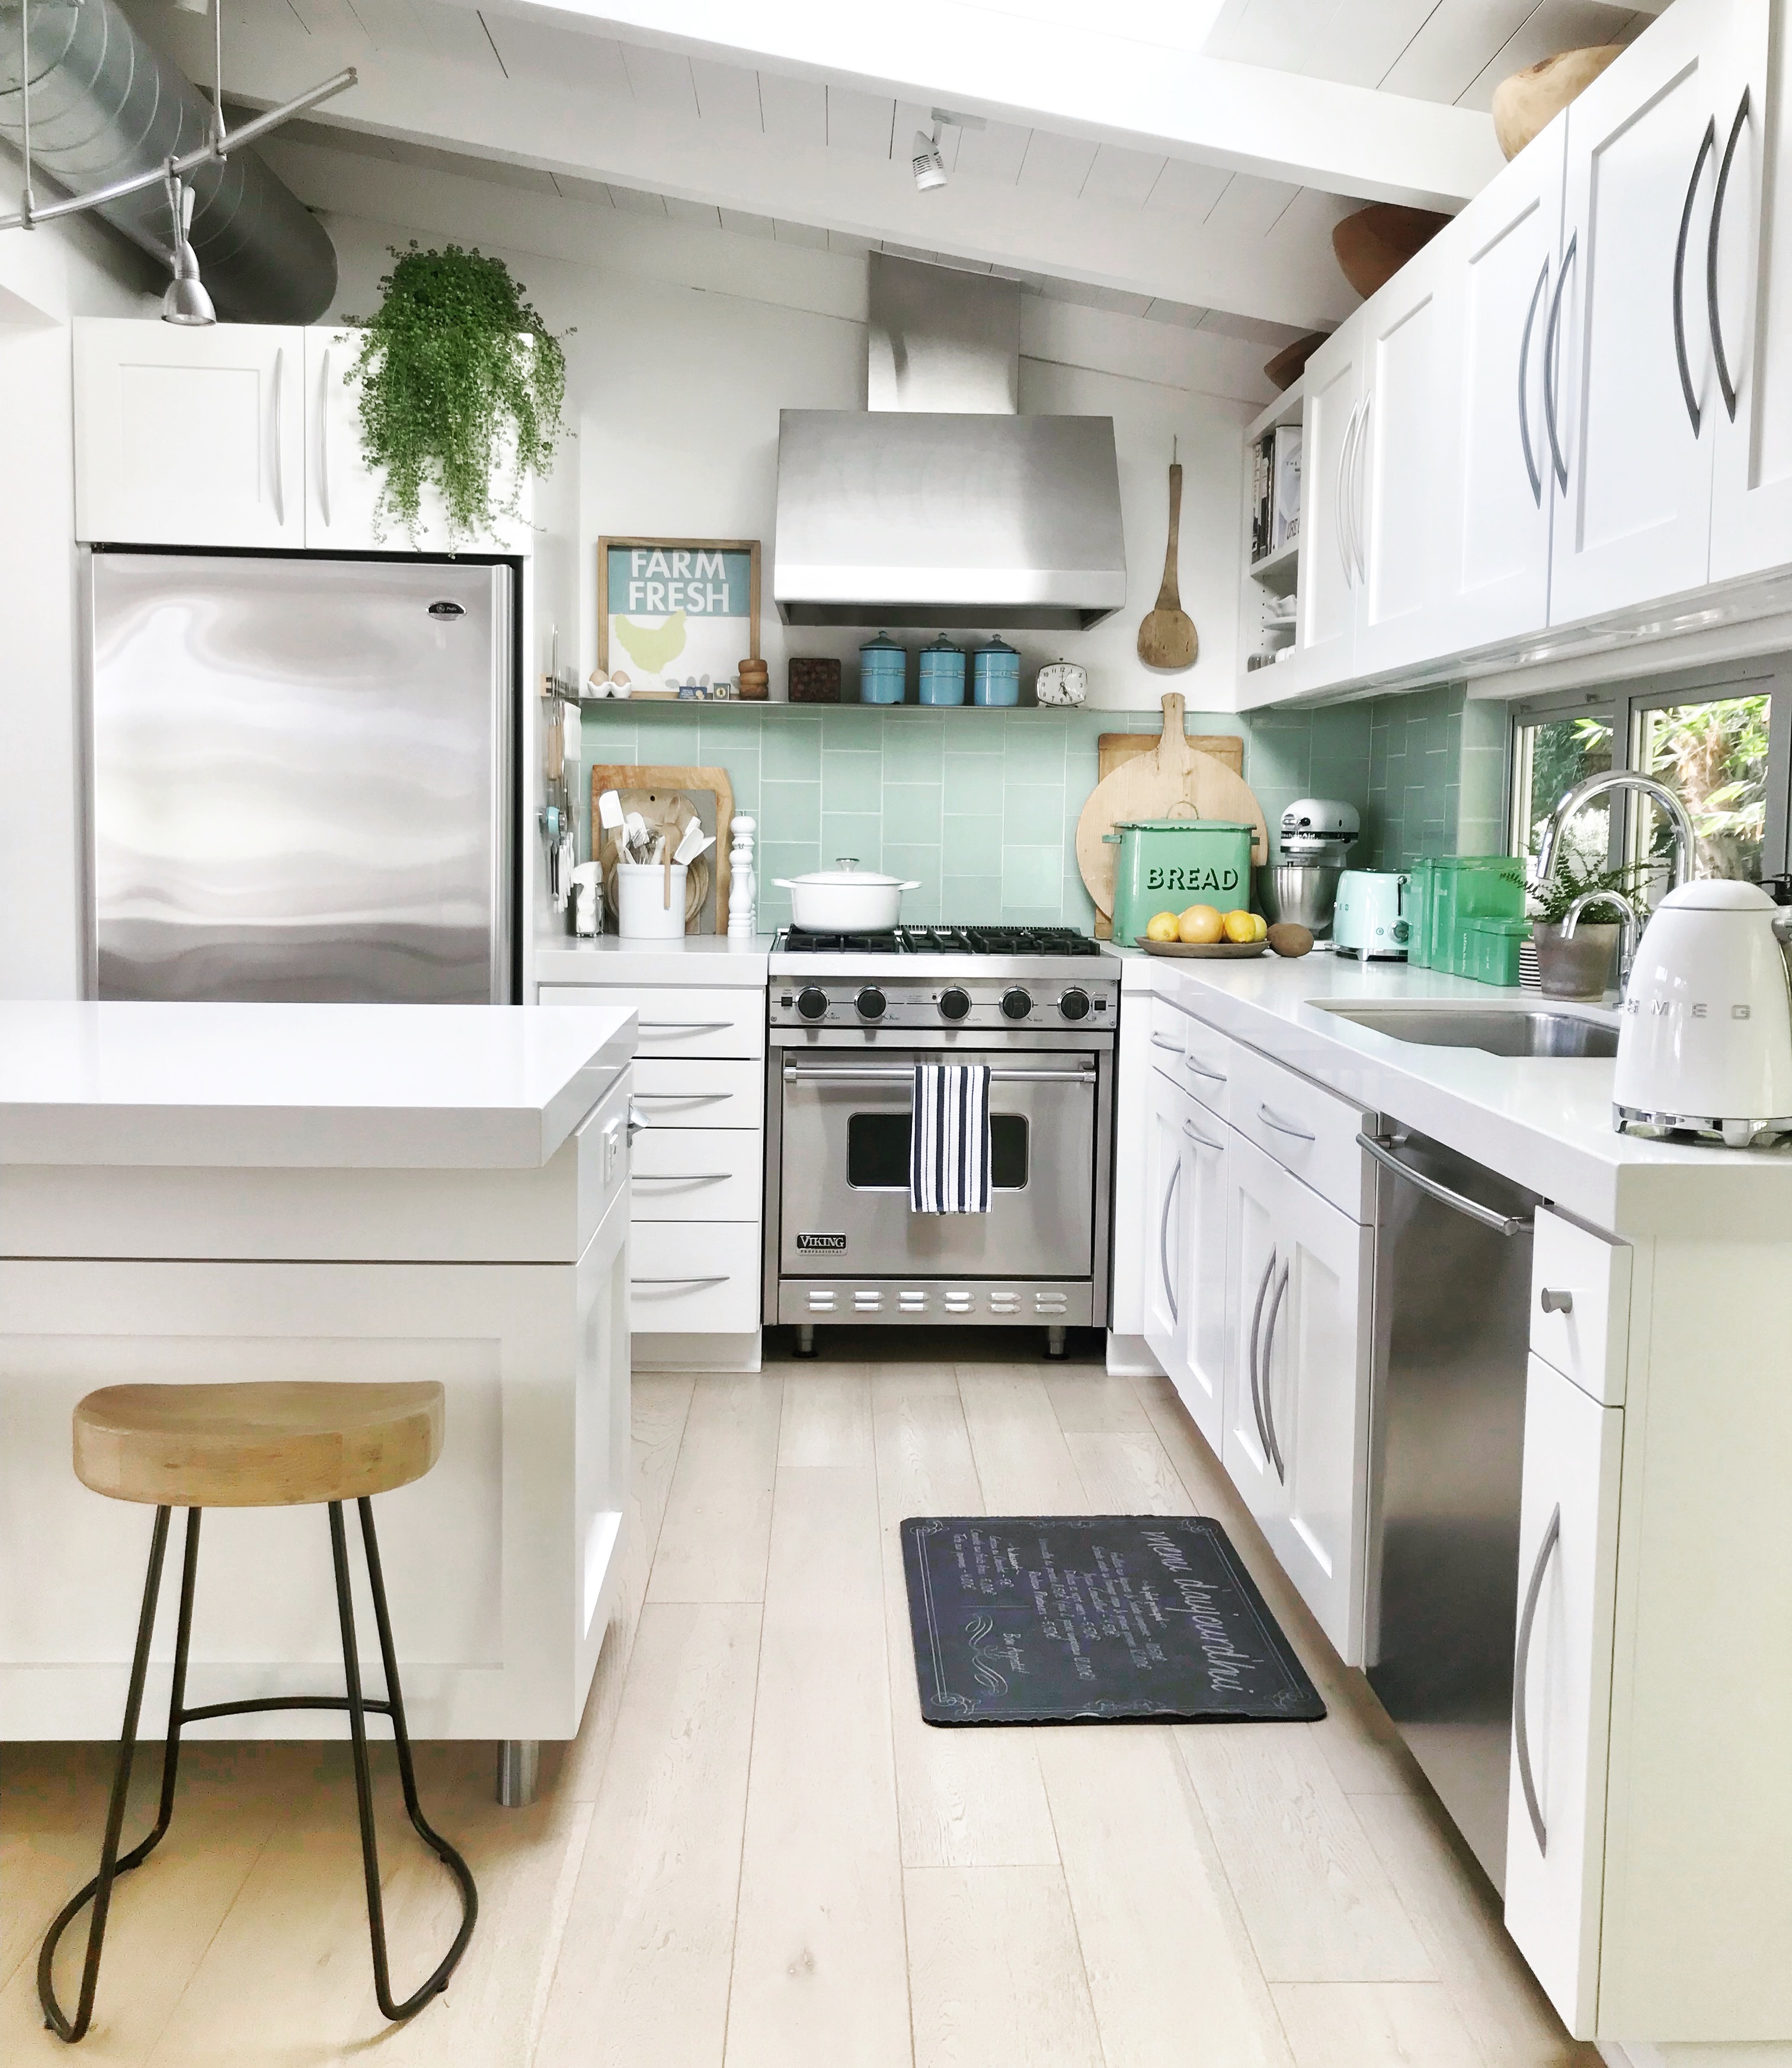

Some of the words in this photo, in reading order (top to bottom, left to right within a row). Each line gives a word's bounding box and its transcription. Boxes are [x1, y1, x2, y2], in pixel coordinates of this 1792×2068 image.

[631, 548, 726, 580] FARM
[629, 581, 729, 613] FRESH
[1147, 867, 1239, 890] BREAD
[1627, 998, 1752, 1020] SMEG
[800, 1236, 844, 1247] VIKING
[1140, 1531, 1192, 1572] menu
